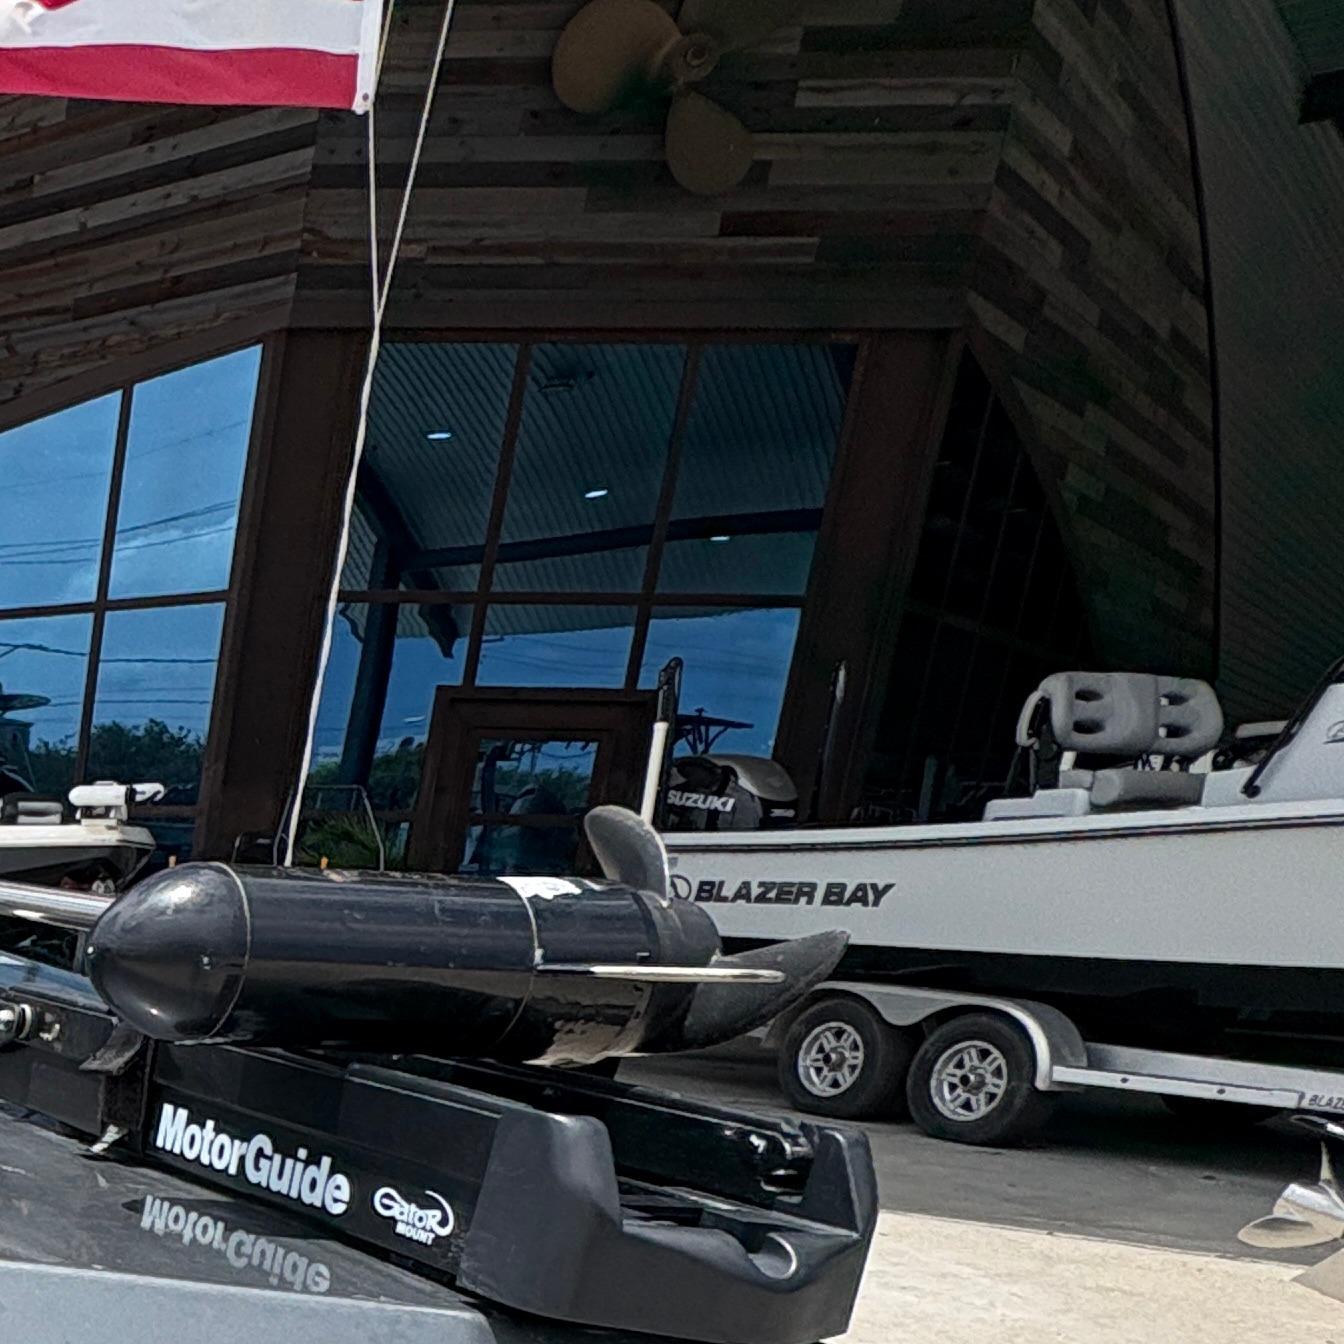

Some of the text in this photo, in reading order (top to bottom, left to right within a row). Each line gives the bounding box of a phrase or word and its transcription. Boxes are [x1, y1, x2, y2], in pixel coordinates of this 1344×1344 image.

[666, 790, 735, 812] SUZUKI
[694, 880, 896, 908] BLAZER BAY
[1309, 1094, 1344, 1111] BLAZ
[155, 1102, 351, 1216] MotorGuide
[395, 1221, 436, 1246] MOUNT
